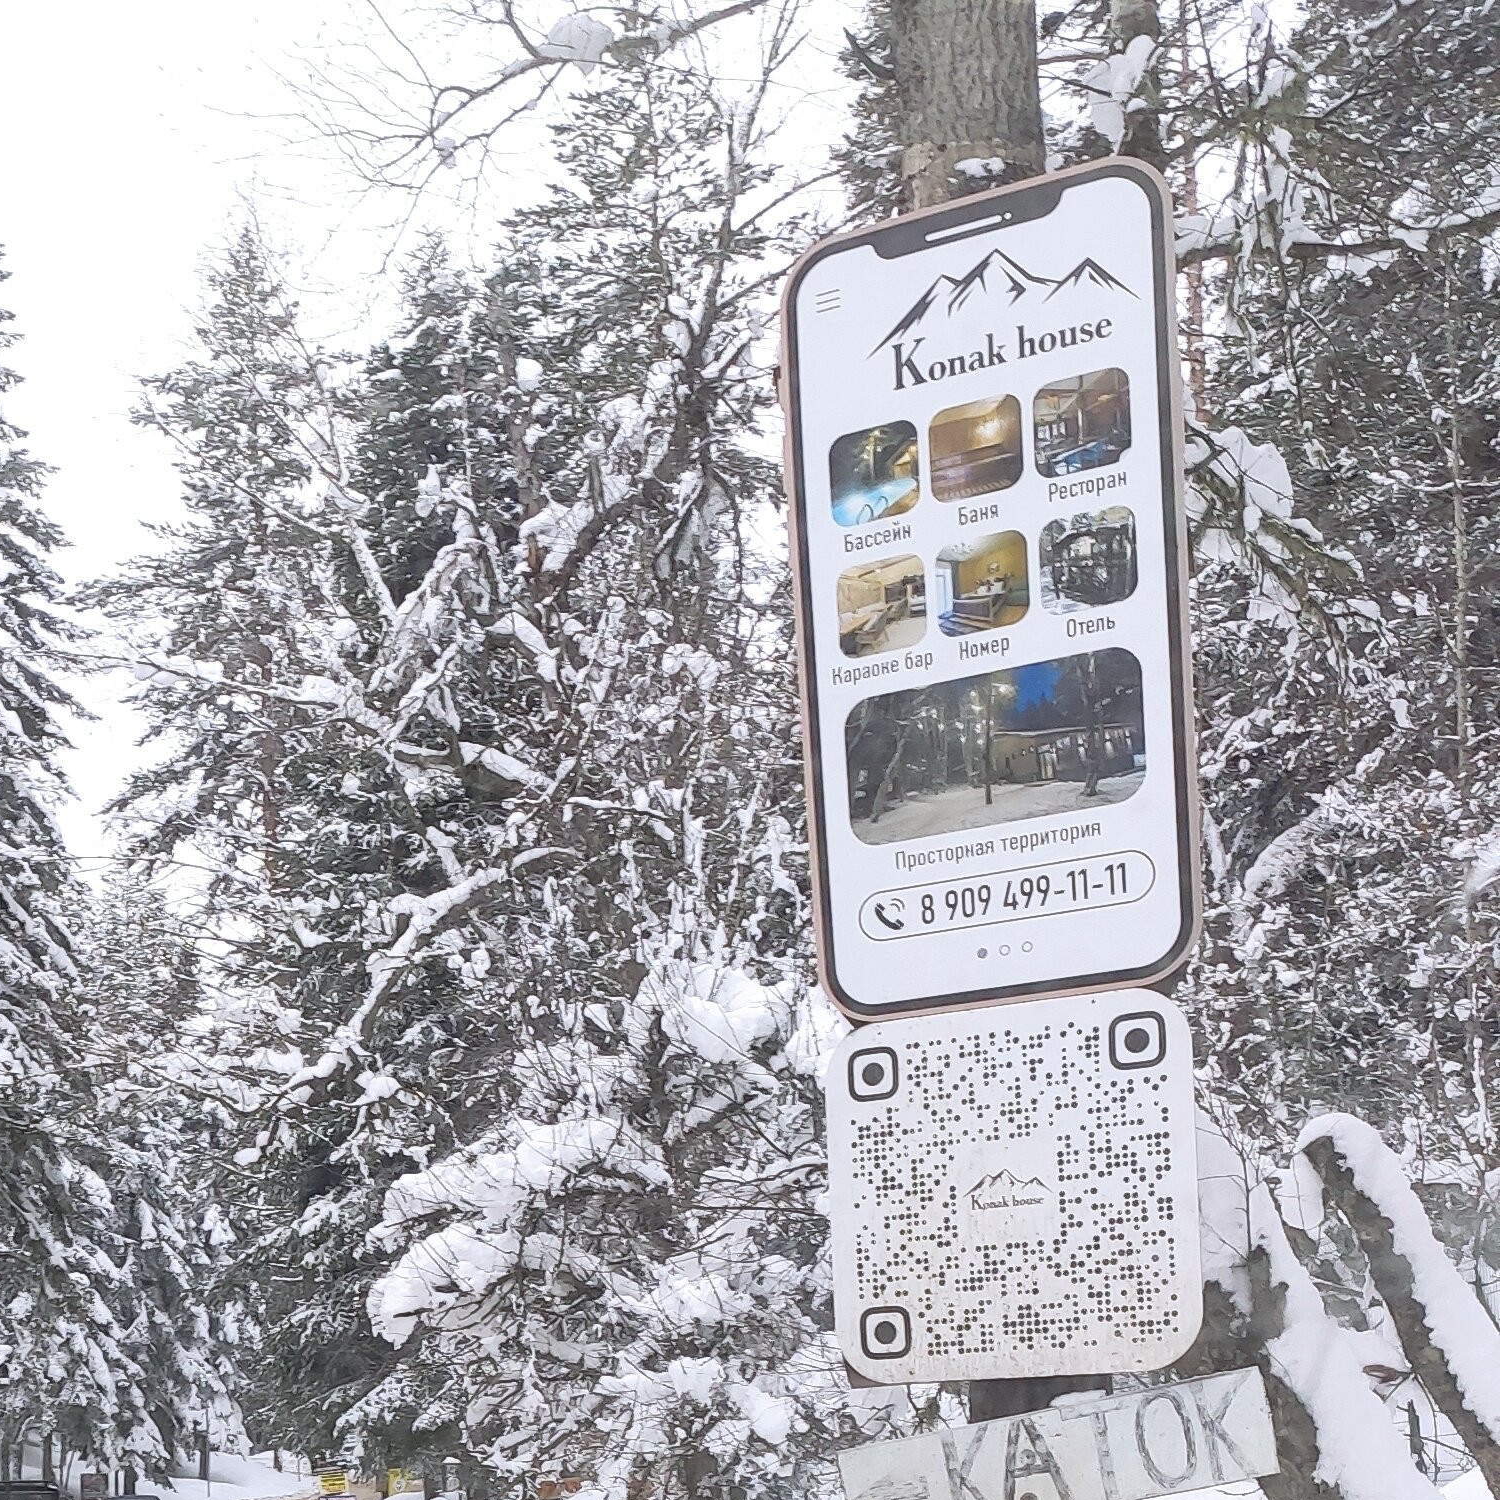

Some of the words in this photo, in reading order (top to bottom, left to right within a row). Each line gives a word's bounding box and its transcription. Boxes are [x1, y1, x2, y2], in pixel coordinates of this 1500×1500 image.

[891, 333, 1006, 391] Konak
[1016, 317, 1113, 360] house
[1048, 470, 1128, 502] Ресторан
[957, 503, 1000, 526] Баня
[843, 520, 912, 553] Бассейн
[1065, 616, 1116, 638] Отель
[958, 636, 1011, 661] Номер
[831, 658, 901, 686] Караоке
[904, 650, 934, 674] бар
[895, 839, 995, 871] Просторная
[999, 822, 1102, 855] территория
[920, 893, 936, 925] 8
[944, 884, 992, 921] 909
[1002, 861, 1129, 912] 499-11-11
